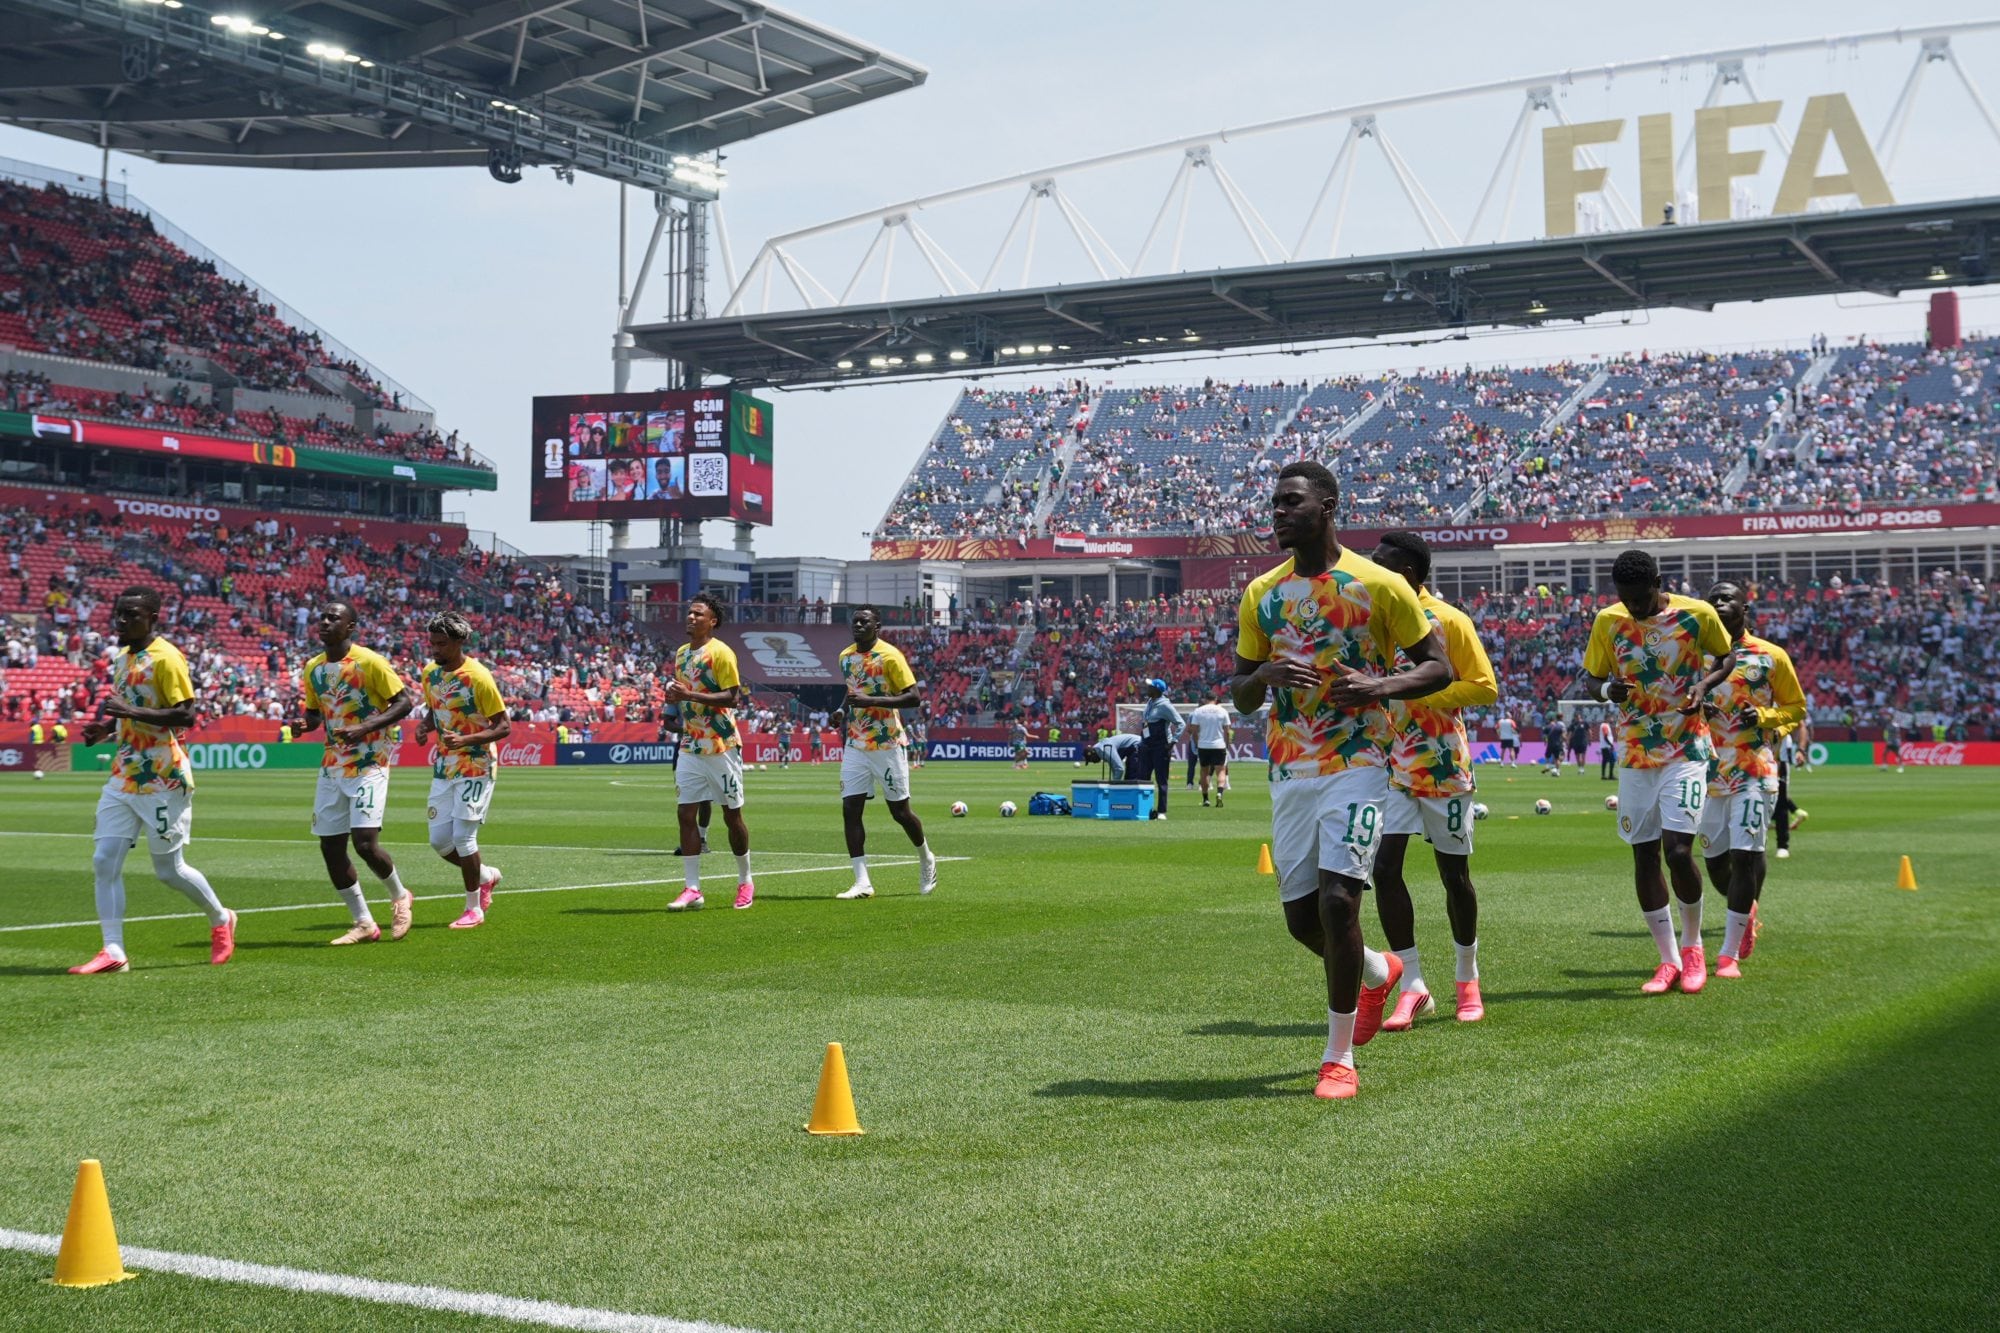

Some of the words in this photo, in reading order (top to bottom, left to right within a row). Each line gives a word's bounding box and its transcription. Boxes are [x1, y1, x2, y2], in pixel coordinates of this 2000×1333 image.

[1542, 92, 1896, 237] FIFA
[693, 399, 724, 413] SCAN
[694, 420, 723, 433] CODE
[113, 499, 221, 521] TORONTO
[1743, 516, 1779, 531] FIFA
[1780, 514, 1842, 529] WORLD
[1843, 512, 1879, 527] CUP
[1880, 509, 1942, 526] 2026
[1409, 528, 1509, 543] RONTO
[1184, 589, 1209, 599] FIFA
[1211, 589, 1239, 599] WOR
[186, 743, 267, 769] amco
[633, 746, 674, 760] HYUND
[756, 744, 802, 761] Lenvo
[823, 744, 844, 761] Len
[931, 743, 966, 759] ADI
[969, 745, 1076, 759] PREDICSTREET
[721, 774, 738, 794] 14
[884, 768, 894, 788] 4
[355, 785, 374, 809] 21
[462, 780, 482, 802] 20
[1678, 779, 1701, 809] 18
[155, 805, 169, 834] 5
[1342, 802, 1376, 847] 19
[1447, 799, 1462, 832] 8
[1740, 799, 1764, 829] 15
